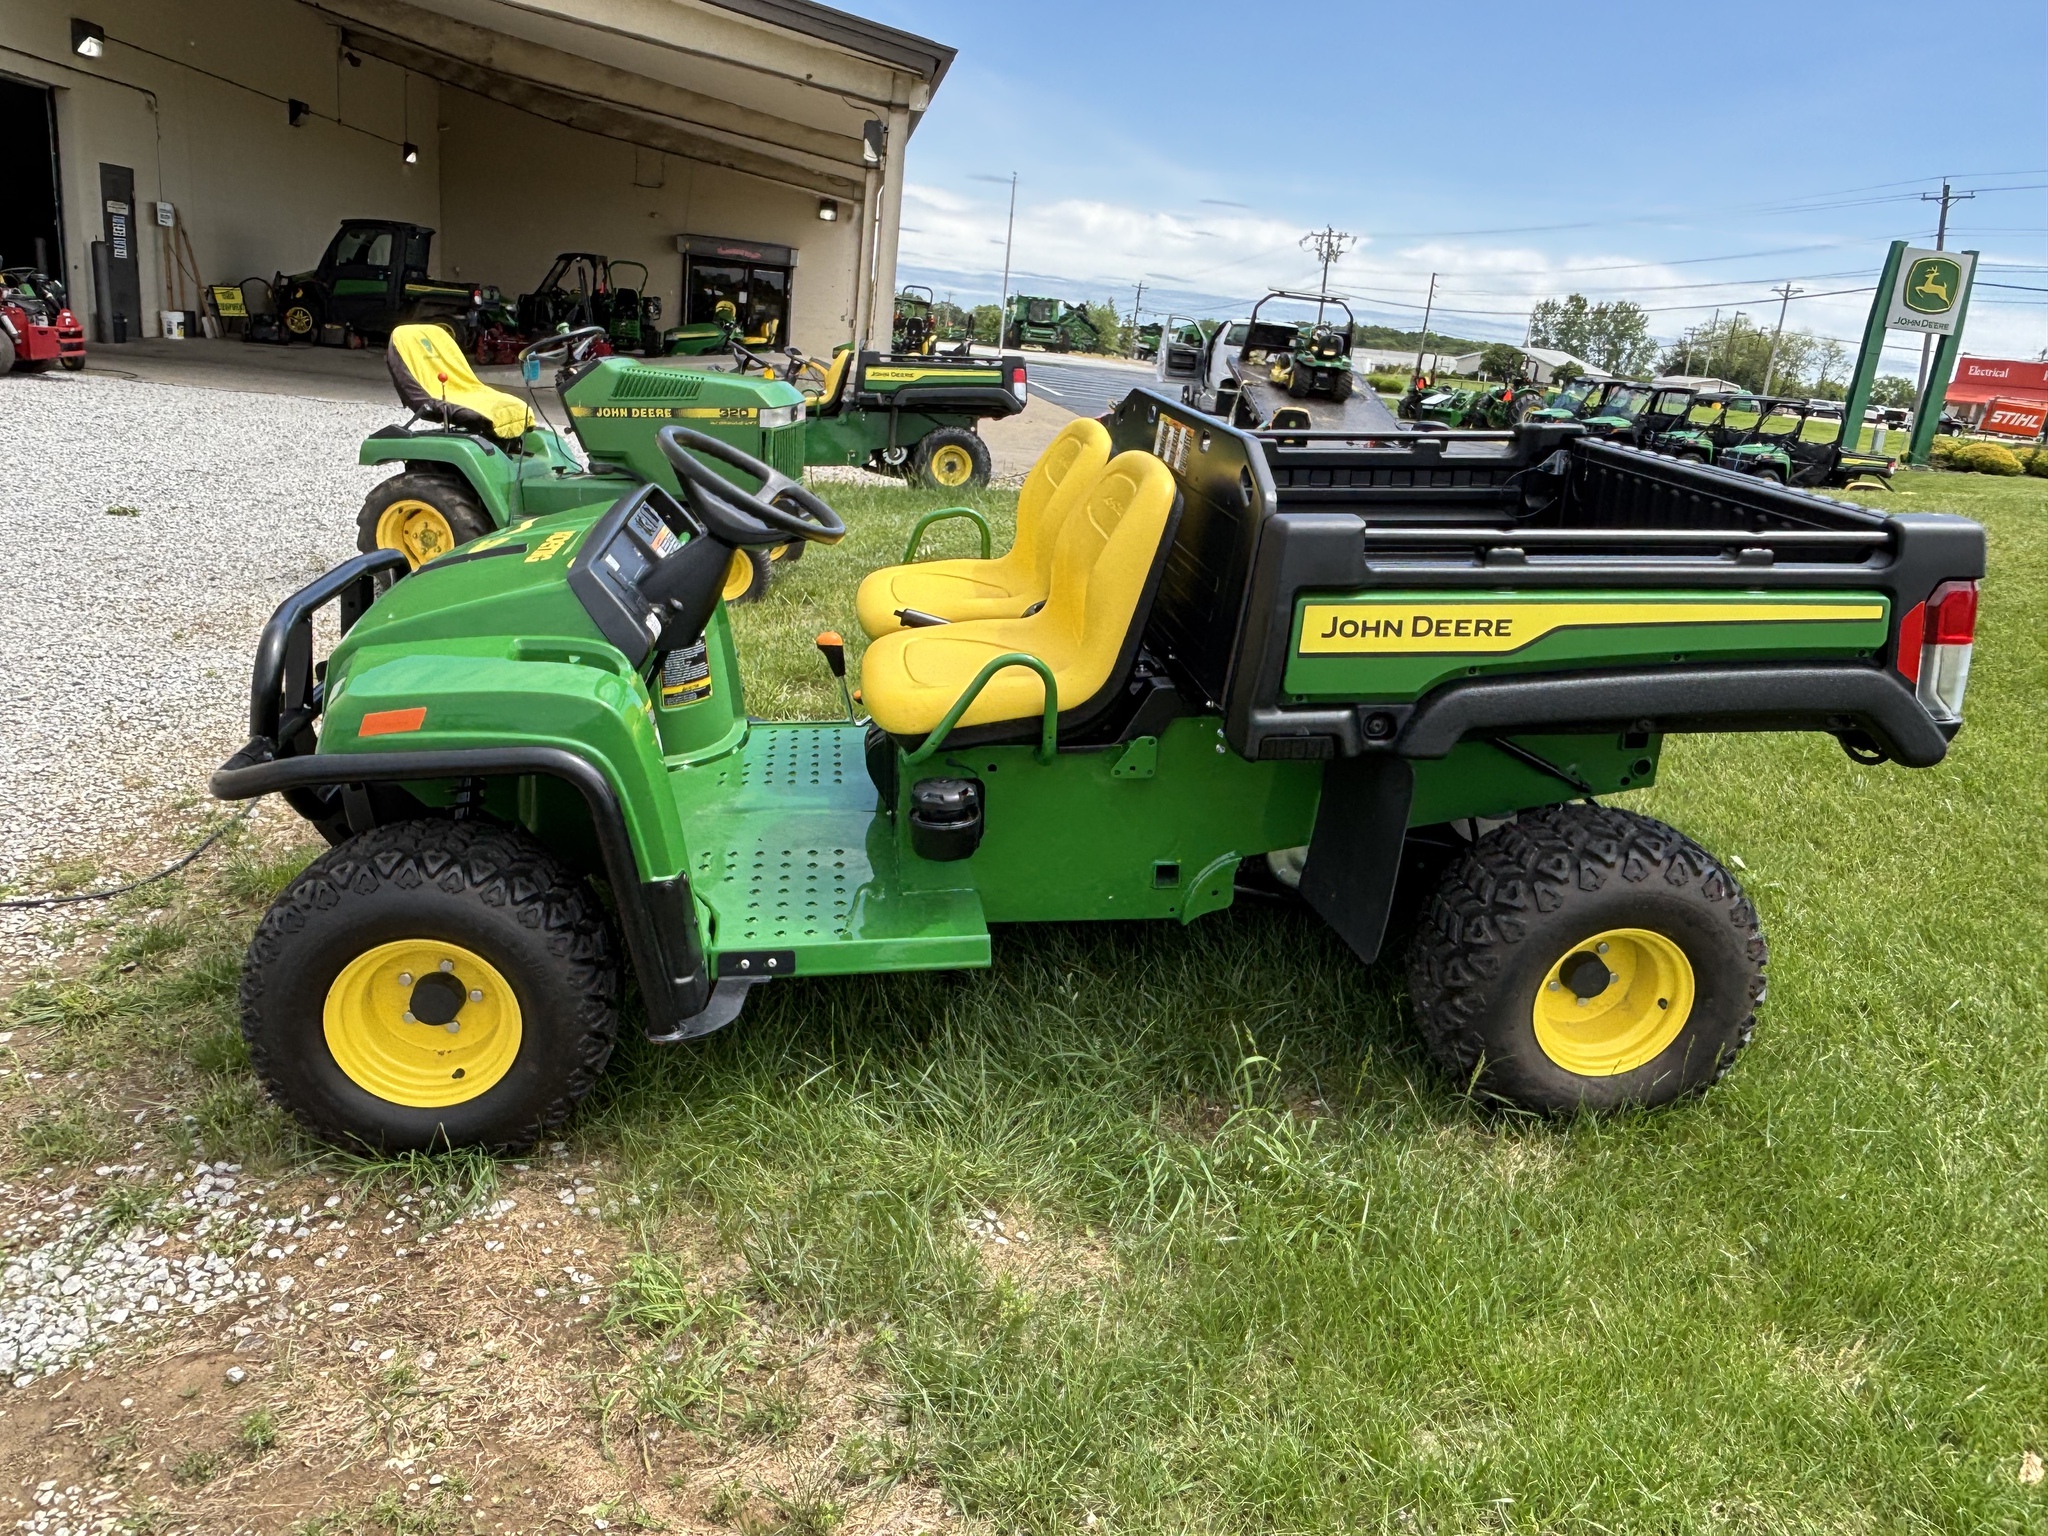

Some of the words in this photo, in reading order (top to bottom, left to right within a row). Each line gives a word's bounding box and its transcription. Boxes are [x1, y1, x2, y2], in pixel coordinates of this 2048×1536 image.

[1893, 316, 1921, 327] JOHN
[1921, 319, 1950, 330] DEERE
[1968, 365, 2010, 378] Electrical
[596, 407, 628, 418] JOHN
[631, 407, 672, 418] DEERE
[1991, 410, 2040, 428] STIHL
[1321, 615, 1404, 638] JOHN
[1411, 615, 1513, 638] DEERE
